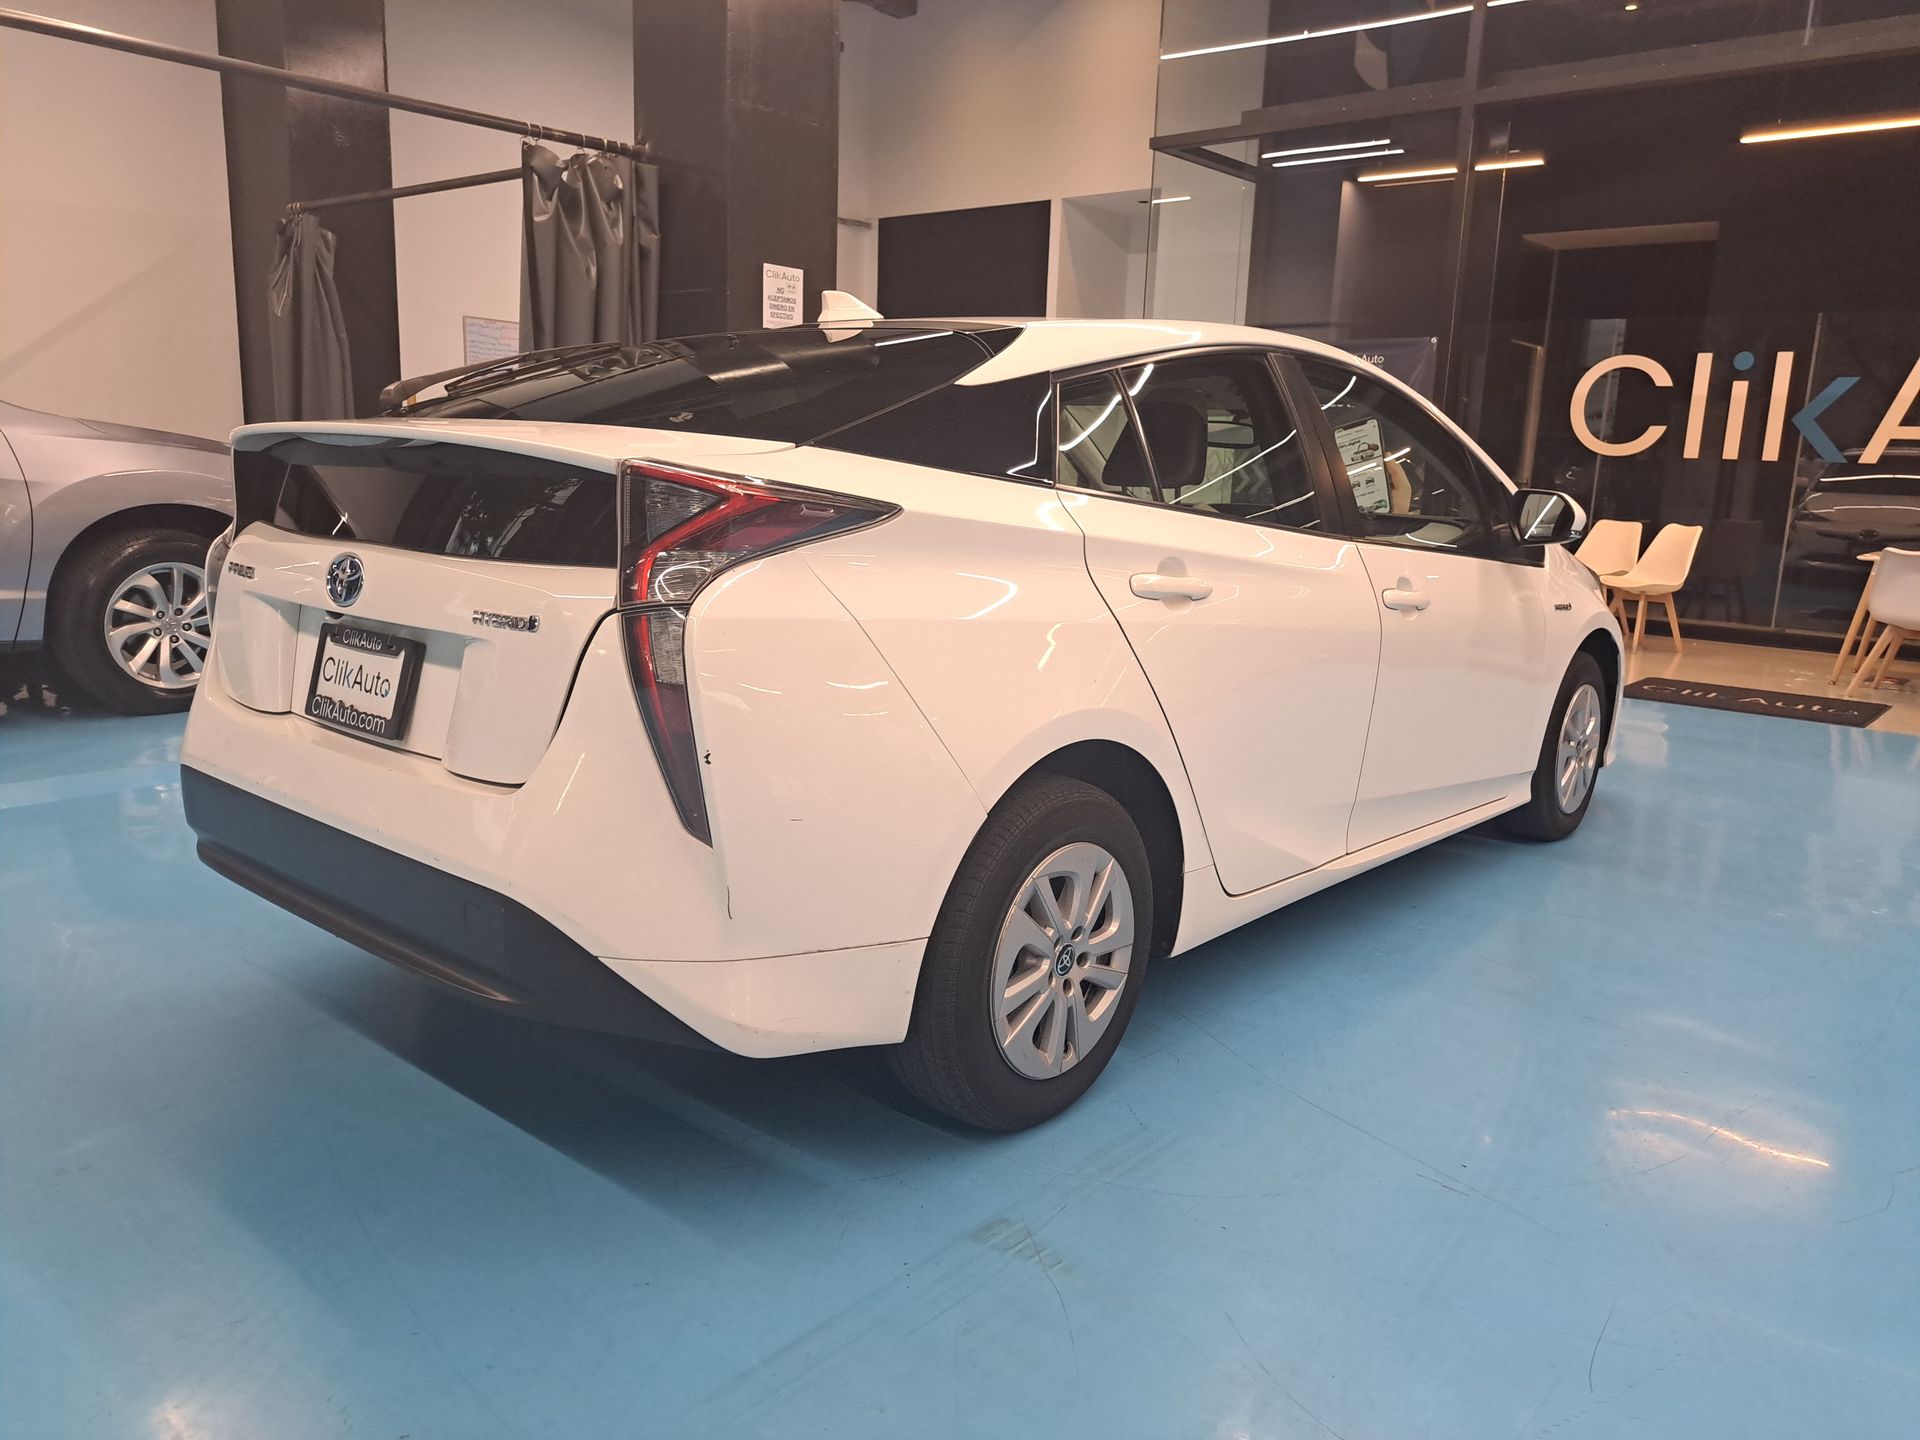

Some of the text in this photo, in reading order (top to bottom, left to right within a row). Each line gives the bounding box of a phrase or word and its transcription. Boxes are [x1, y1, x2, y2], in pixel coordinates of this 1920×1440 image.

[767, 294, 797, 304] ACEPTAMOS
[769, 303, 787, 311] DINERO
[770, 311, 793, 320] EFECTIVO
[342, 628, 383, 651] ClikAuto
[322, 656, 391, 698] ClikAuto
[311, 696, 386, 734] ClikAuto.com
